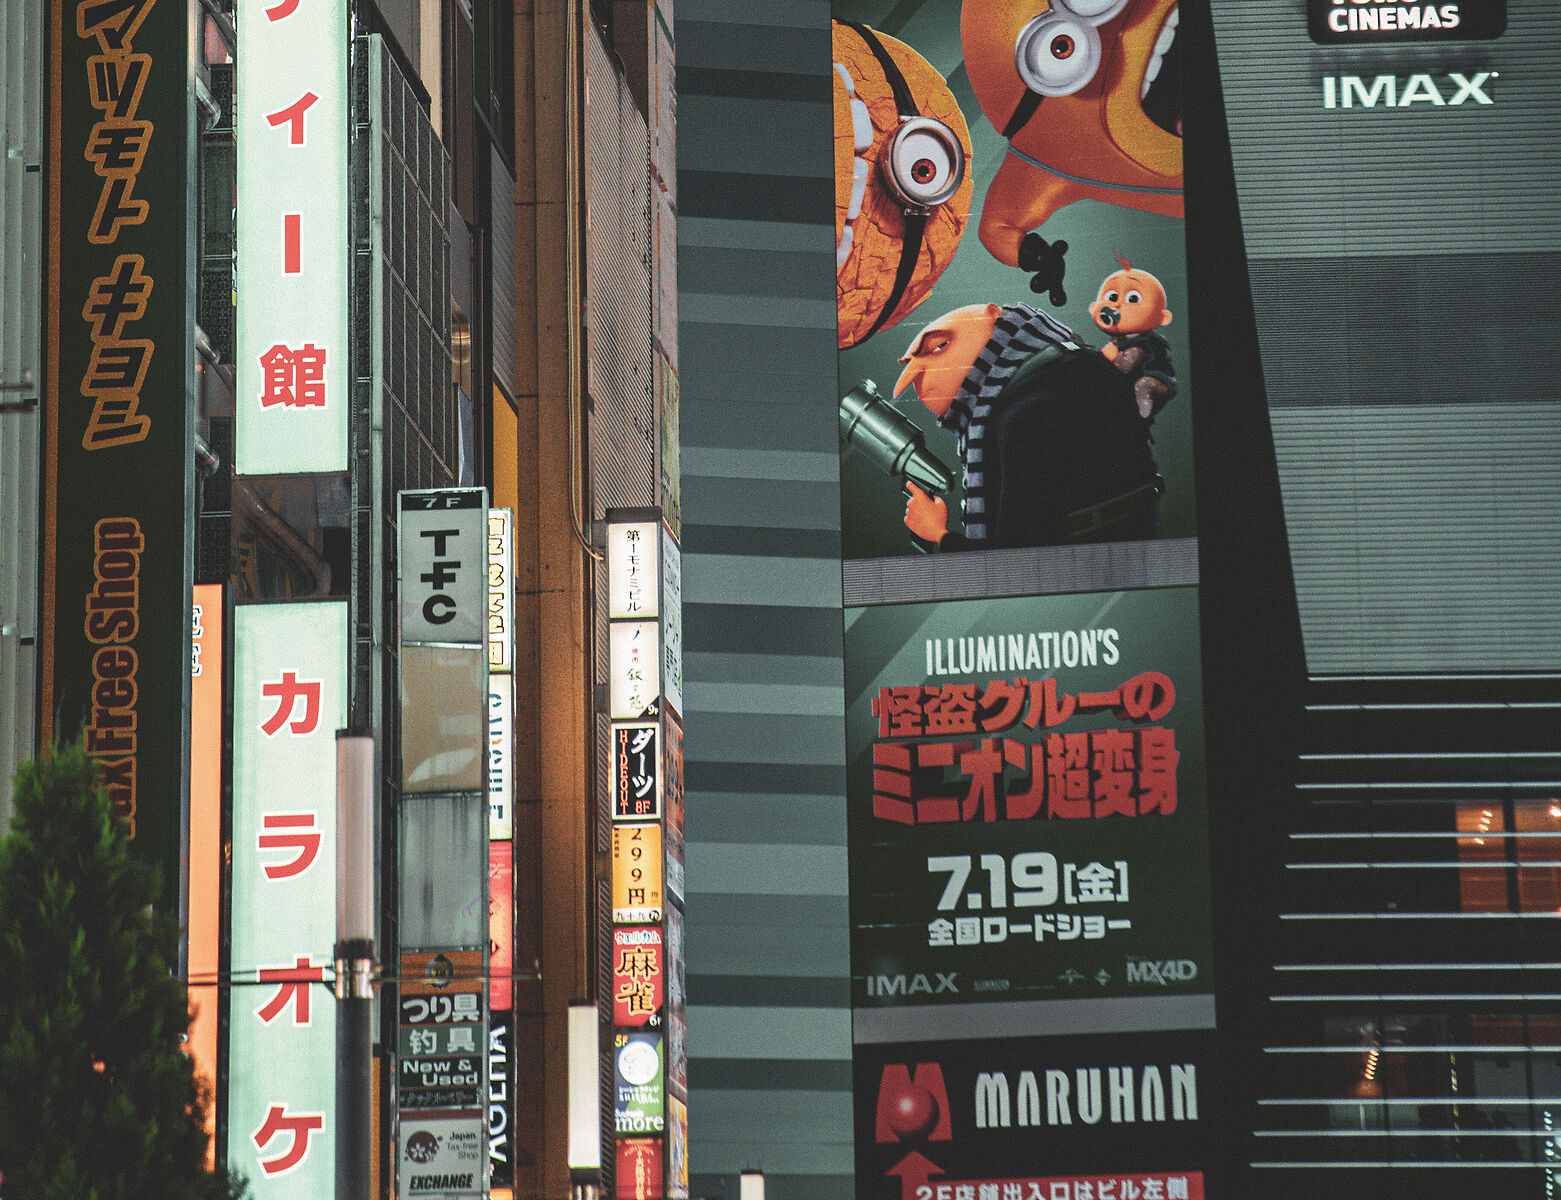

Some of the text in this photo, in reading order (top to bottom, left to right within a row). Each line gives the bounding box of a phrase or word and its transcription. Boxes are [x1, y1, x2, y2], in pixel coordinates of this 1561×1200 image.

[1328, 5, 1460, 33] CINEMAS
[1322, 72, 1494, 109] IMAX
[85, 517, 145, 643] Shop
[925, 627, 1120, 676] ILLUMINATION'S
[85, 646, 138, 755] Free
[872, 671, 1177, 738] 怪盗グルーの
[619, 729, 629, 815] HIDEOUT
[630, 728, 655, 798] ダーツ
[872, 726, 1180, 826] ミニオン超変身
[635, 799, 651, 814] 8F
[627, 827, 646, 905] 299円
[252, 668, 324, 1179] カラオケ
[927, 914, 1132, 946] 全国ロードショー
[402, 992, 480, 1023] つり具
[615, 945, 660, 1016] 麻雀
[866, 971, 960, 997] IMAX
[1126, 958, 1198, 986] MX4D
[614, 1115, 665, 1133] more
[974, 1063, 1199, 1130] MARUHAN
[409, 1173, 474, 1191] EXCHANGE
